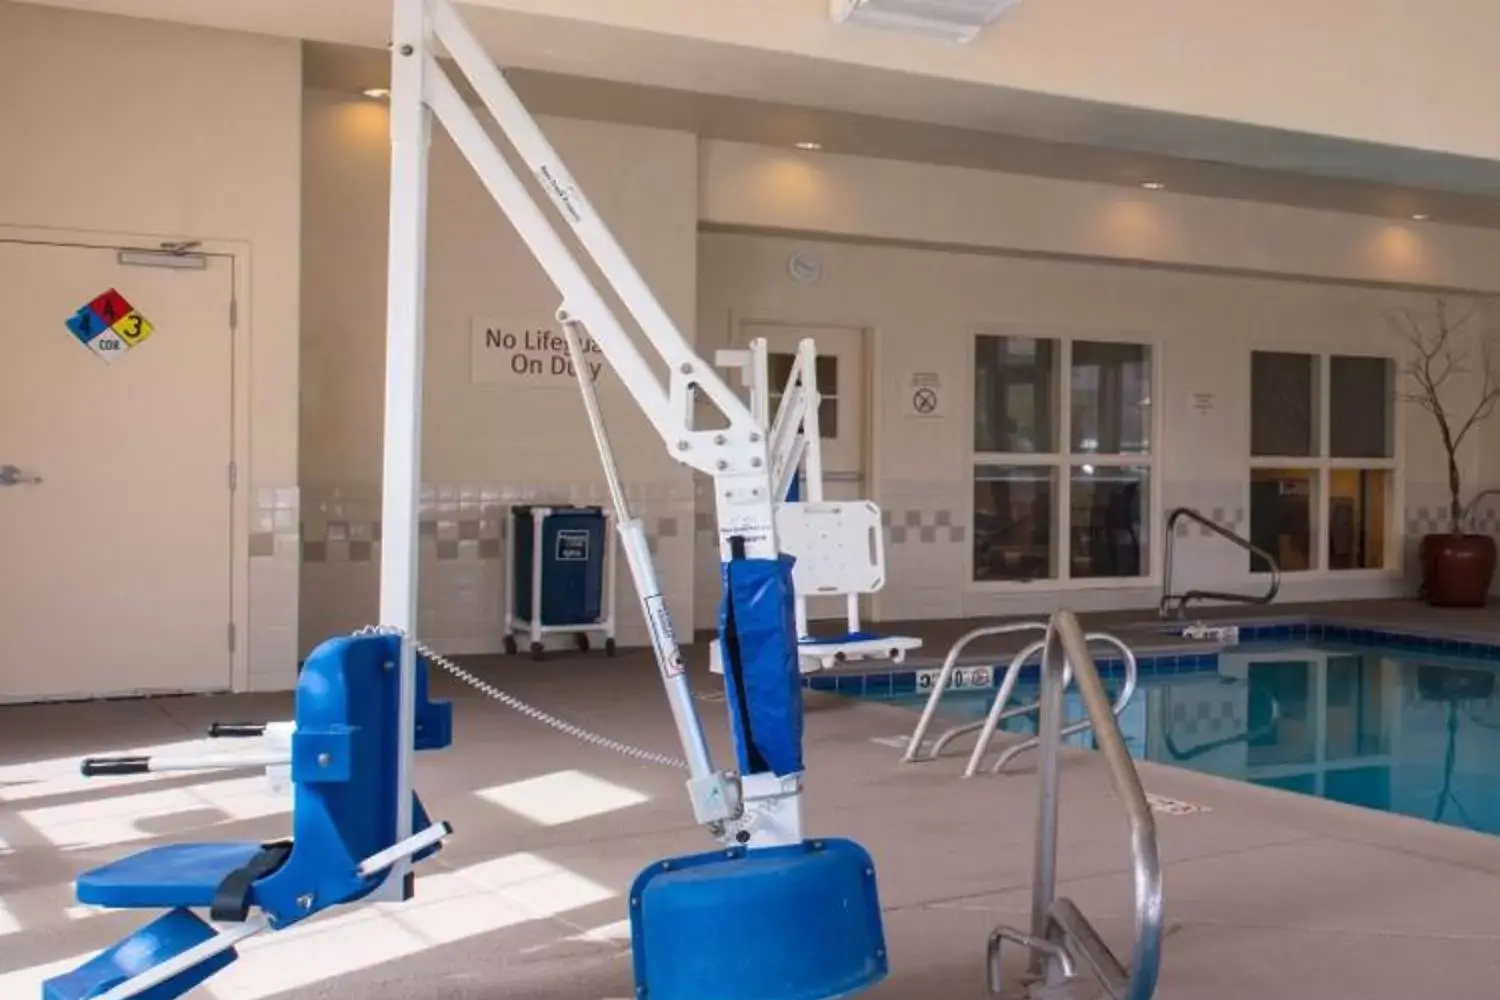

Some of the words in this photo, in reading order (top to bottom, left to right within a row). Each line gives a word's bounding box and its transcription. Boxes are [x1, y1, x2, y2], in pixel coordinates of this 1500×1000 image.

[123, 314, 143, 339] 3
[485, 328, 516, 350] No
[511, 353, 543, 374] On
